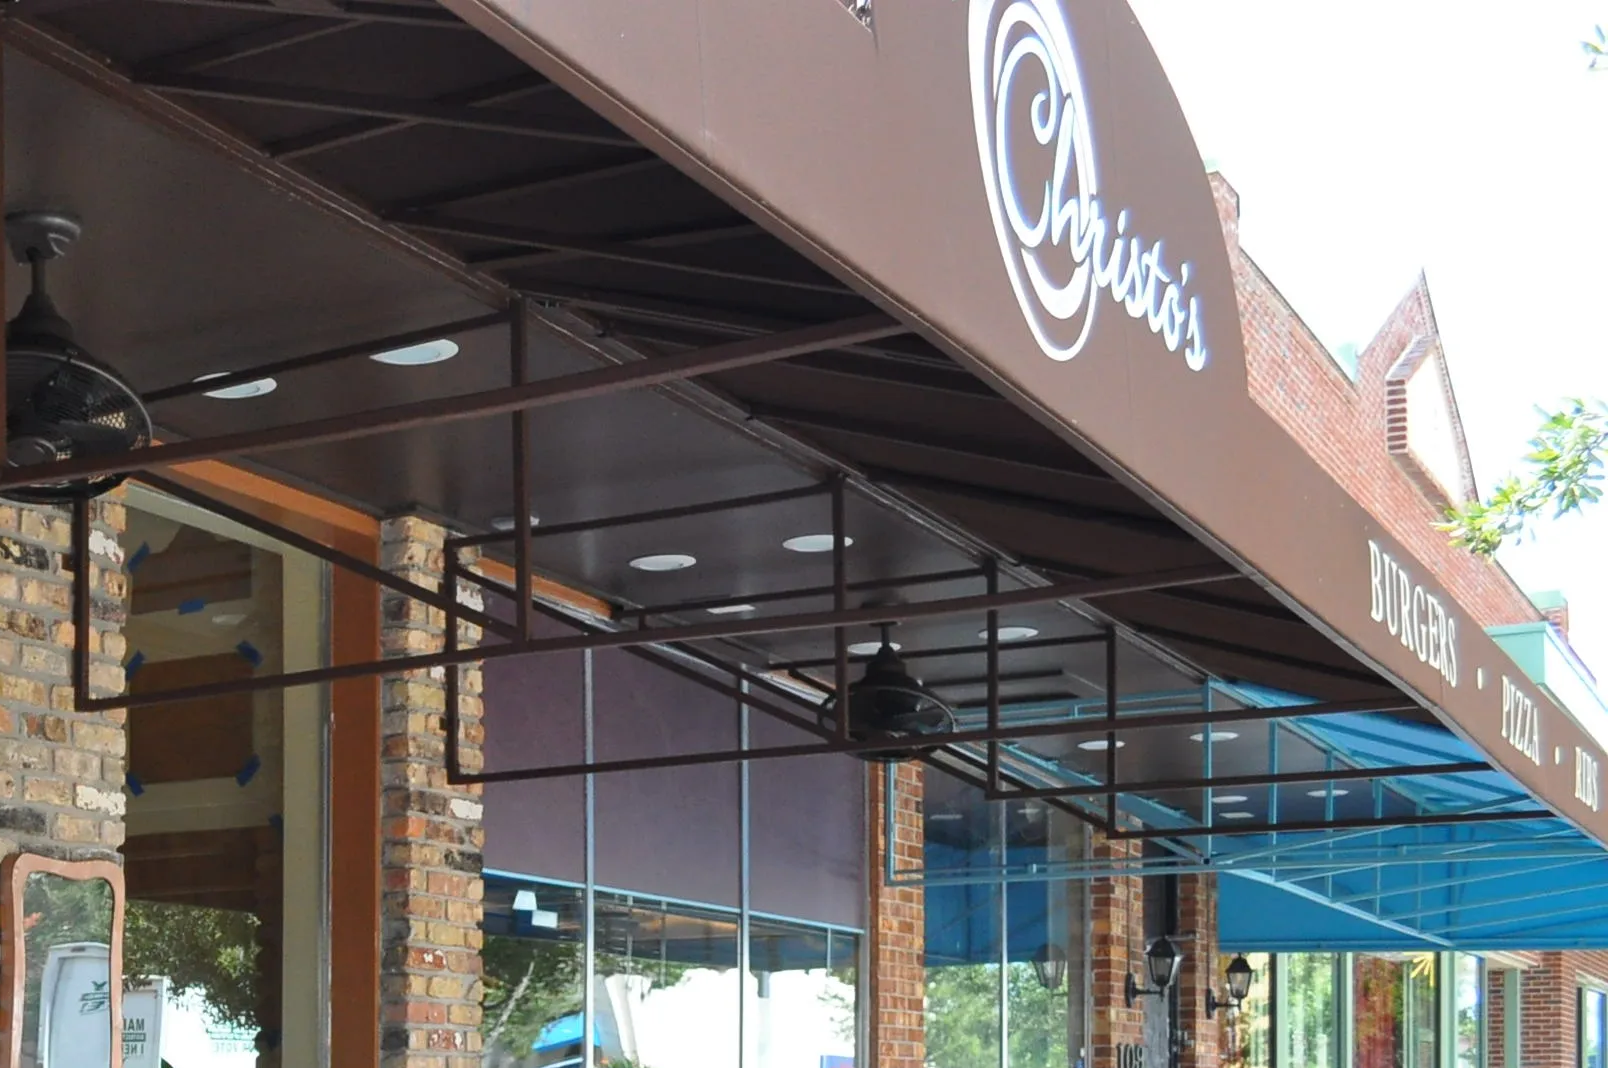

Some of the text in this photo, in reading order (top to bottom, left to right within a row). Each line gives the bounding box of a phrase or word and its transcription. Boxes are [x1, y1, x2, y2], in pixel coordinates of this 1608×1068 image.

[995, 9, 1207, 371] Christo's
[1368, 539, 1599, 812] BURGERS PIZZA RIBS
